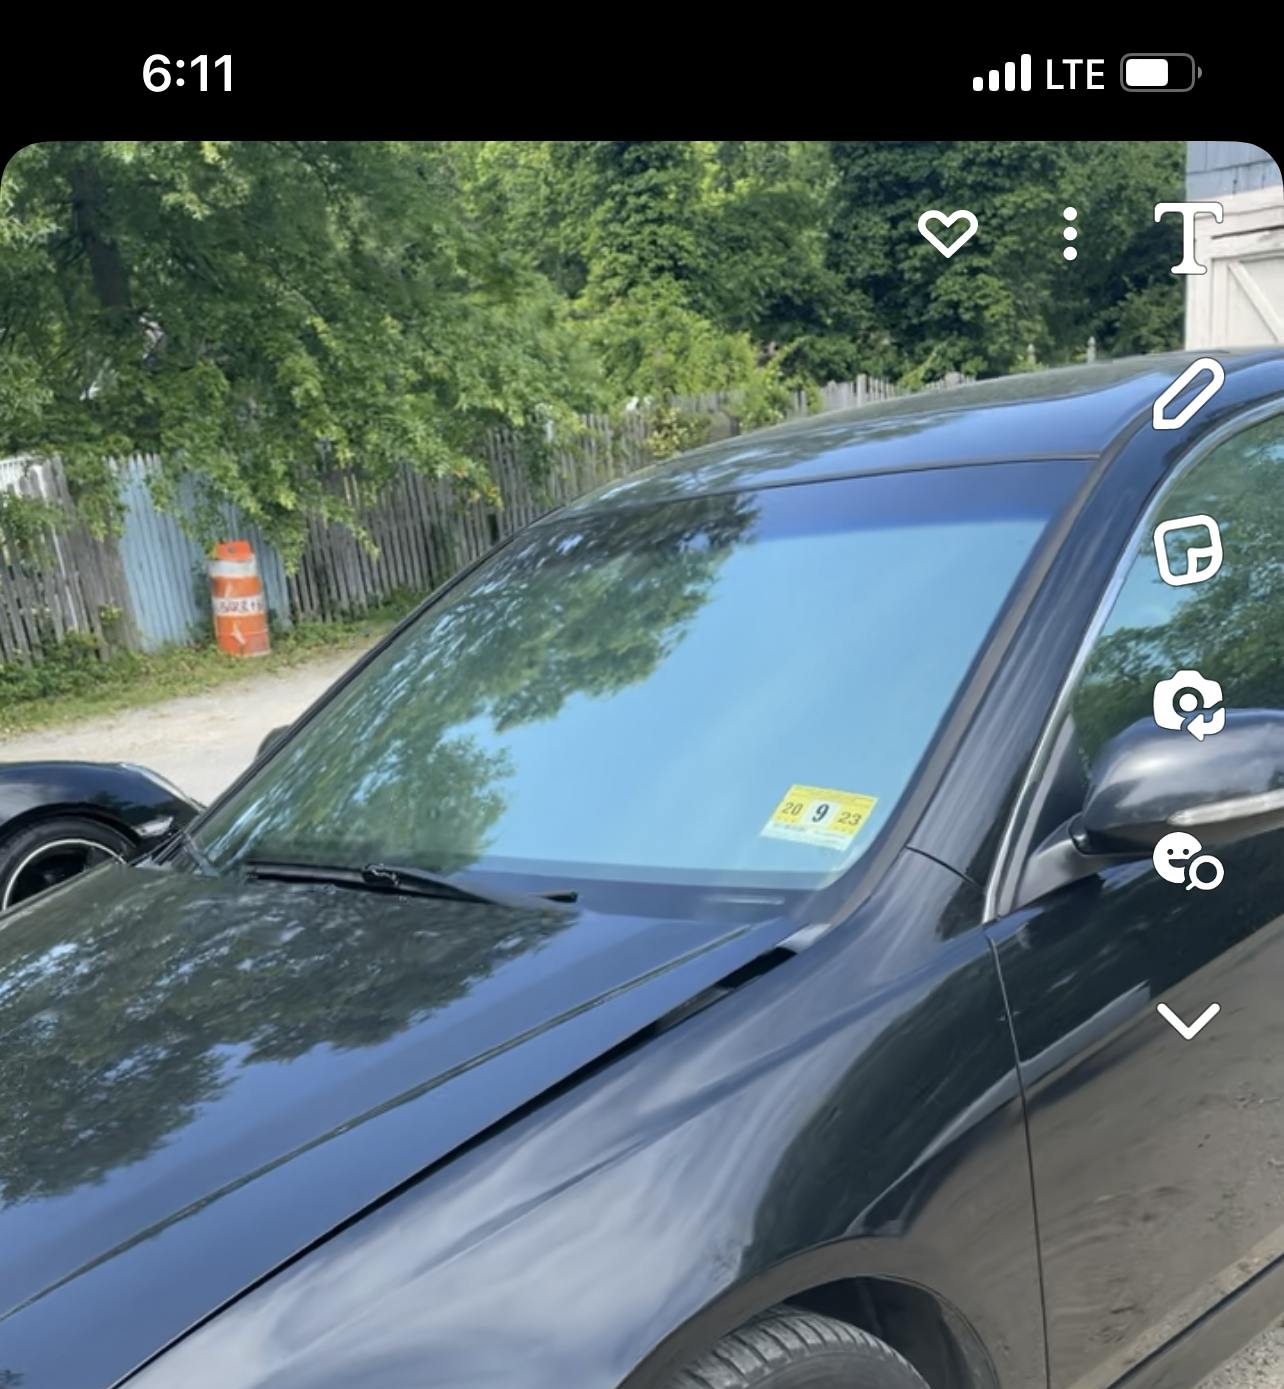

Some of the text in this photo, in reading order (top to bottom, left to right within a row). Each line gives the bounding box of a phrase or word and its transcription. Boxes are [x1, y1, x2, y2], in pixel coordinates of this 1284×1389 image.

[782, 802, 862, 826] 20 9 23
